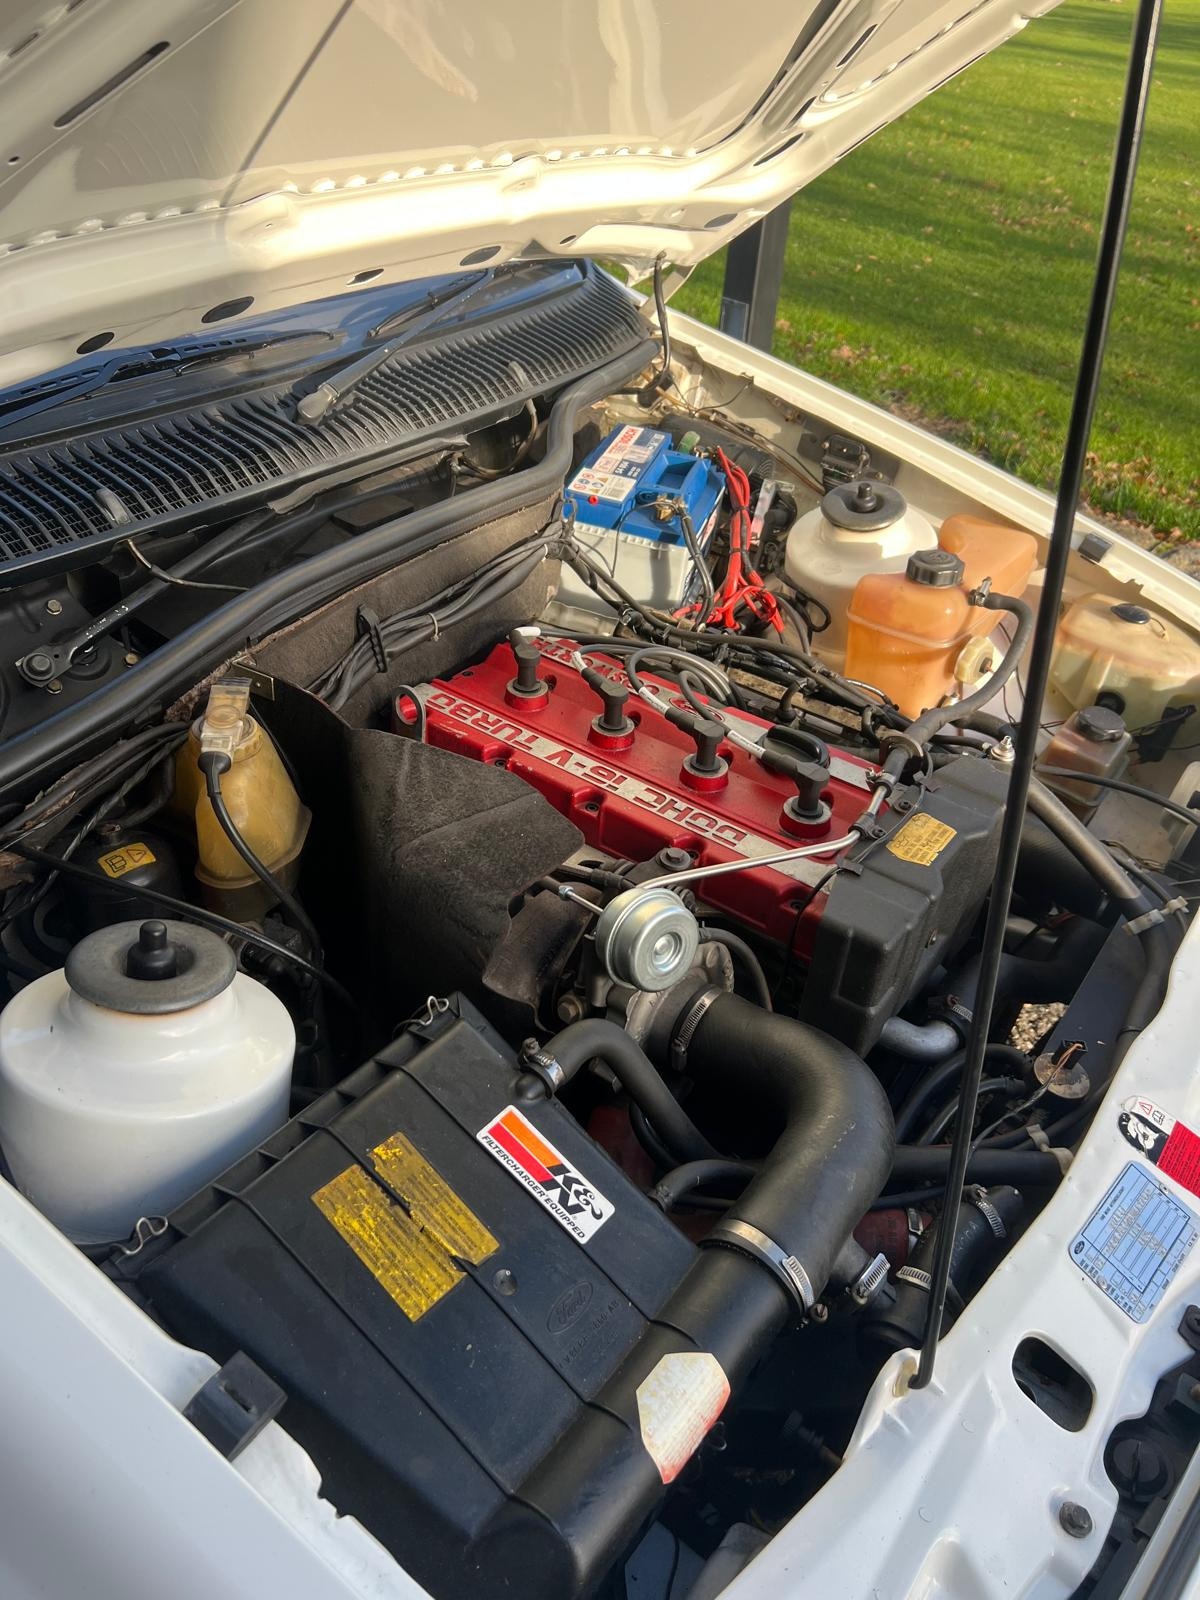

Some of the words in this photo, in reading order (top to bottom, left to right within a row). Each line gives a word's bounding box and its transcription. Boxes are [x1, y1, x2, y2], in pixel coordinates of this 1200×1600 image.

[426, 693, 539, 750] TURBO
[632, 787, 748, 847] DOHC
[481, 1135, 546, 1198] FILTERCHARGER
[545, 1198, 585, 1239] EQUIPPED
